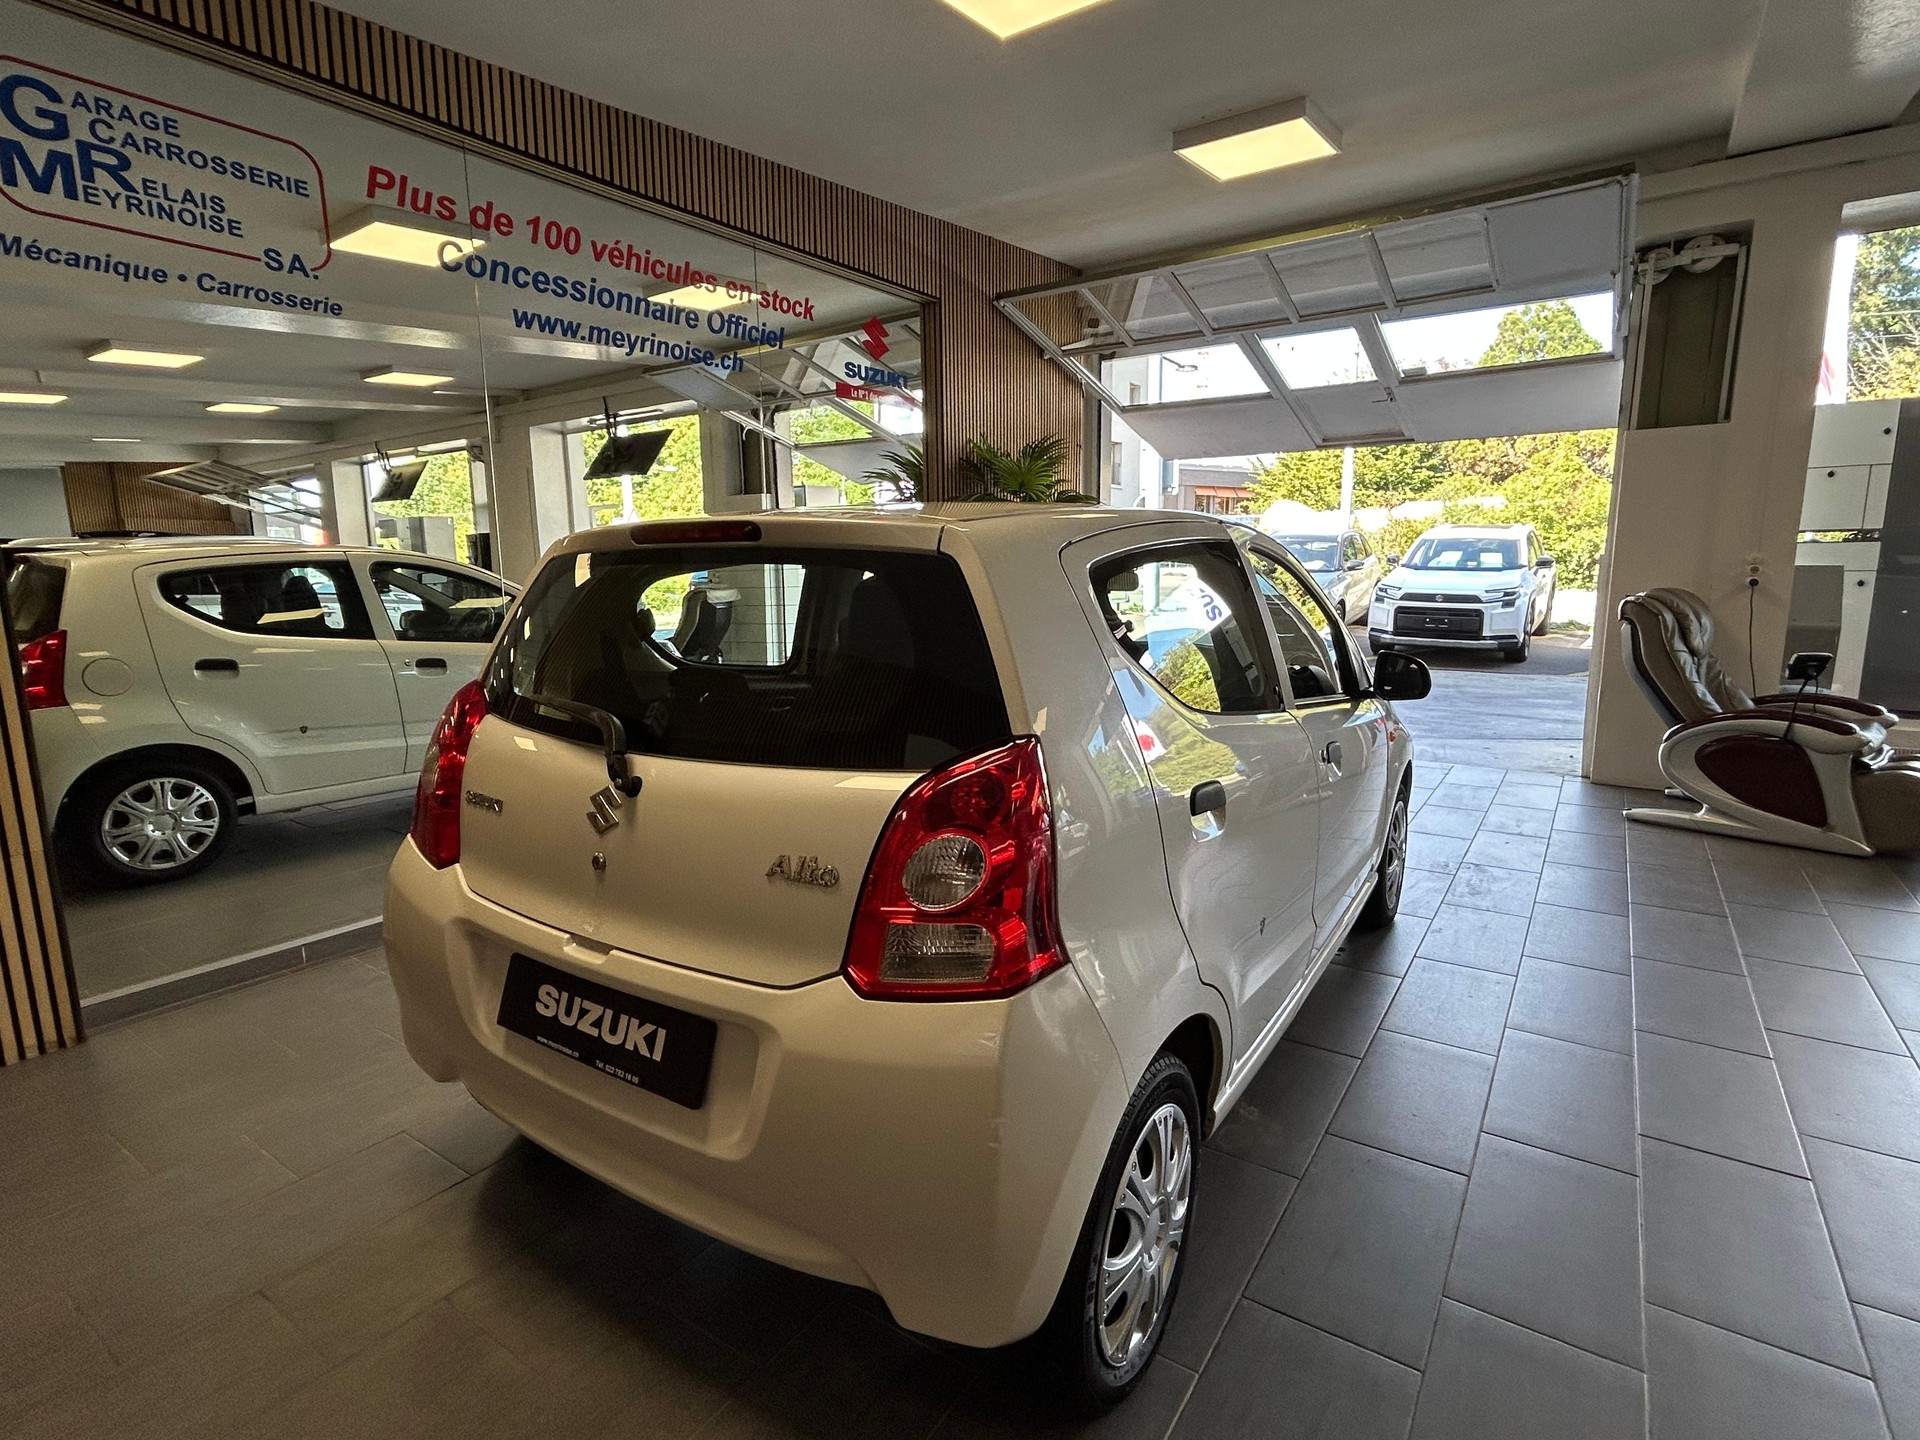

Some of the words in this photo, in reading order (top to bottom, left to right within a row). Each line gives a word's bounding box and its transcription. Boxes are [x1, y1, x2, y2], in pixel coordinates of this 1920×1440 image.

[88, 117, 310, 198] CARROSSERIE
[0, 232, 168, 283] Mécanique
[196, 272, 343, 316] Carrosserie
[263, 247, 319, 280] SA.
[366, 165, 457, 221] Plus
[469, 200, 514, 237] de
[526, 215, 581, 255] 100
[591, 239, 718, 293] véhicules
[725, 280, 752, 304] en
[759, 289, 815, 321] stock
[437, 240, 699, 329] Concessionnaire
[706, 310, 785, 350] Officiel
[513, 308, 744, 373] www.meyrinoise.ch
[844, 361, 908, 390] SUZUKI
[765, 855, 840, 888] Alto
[535, 984, 667, 1062] SUZUKI
